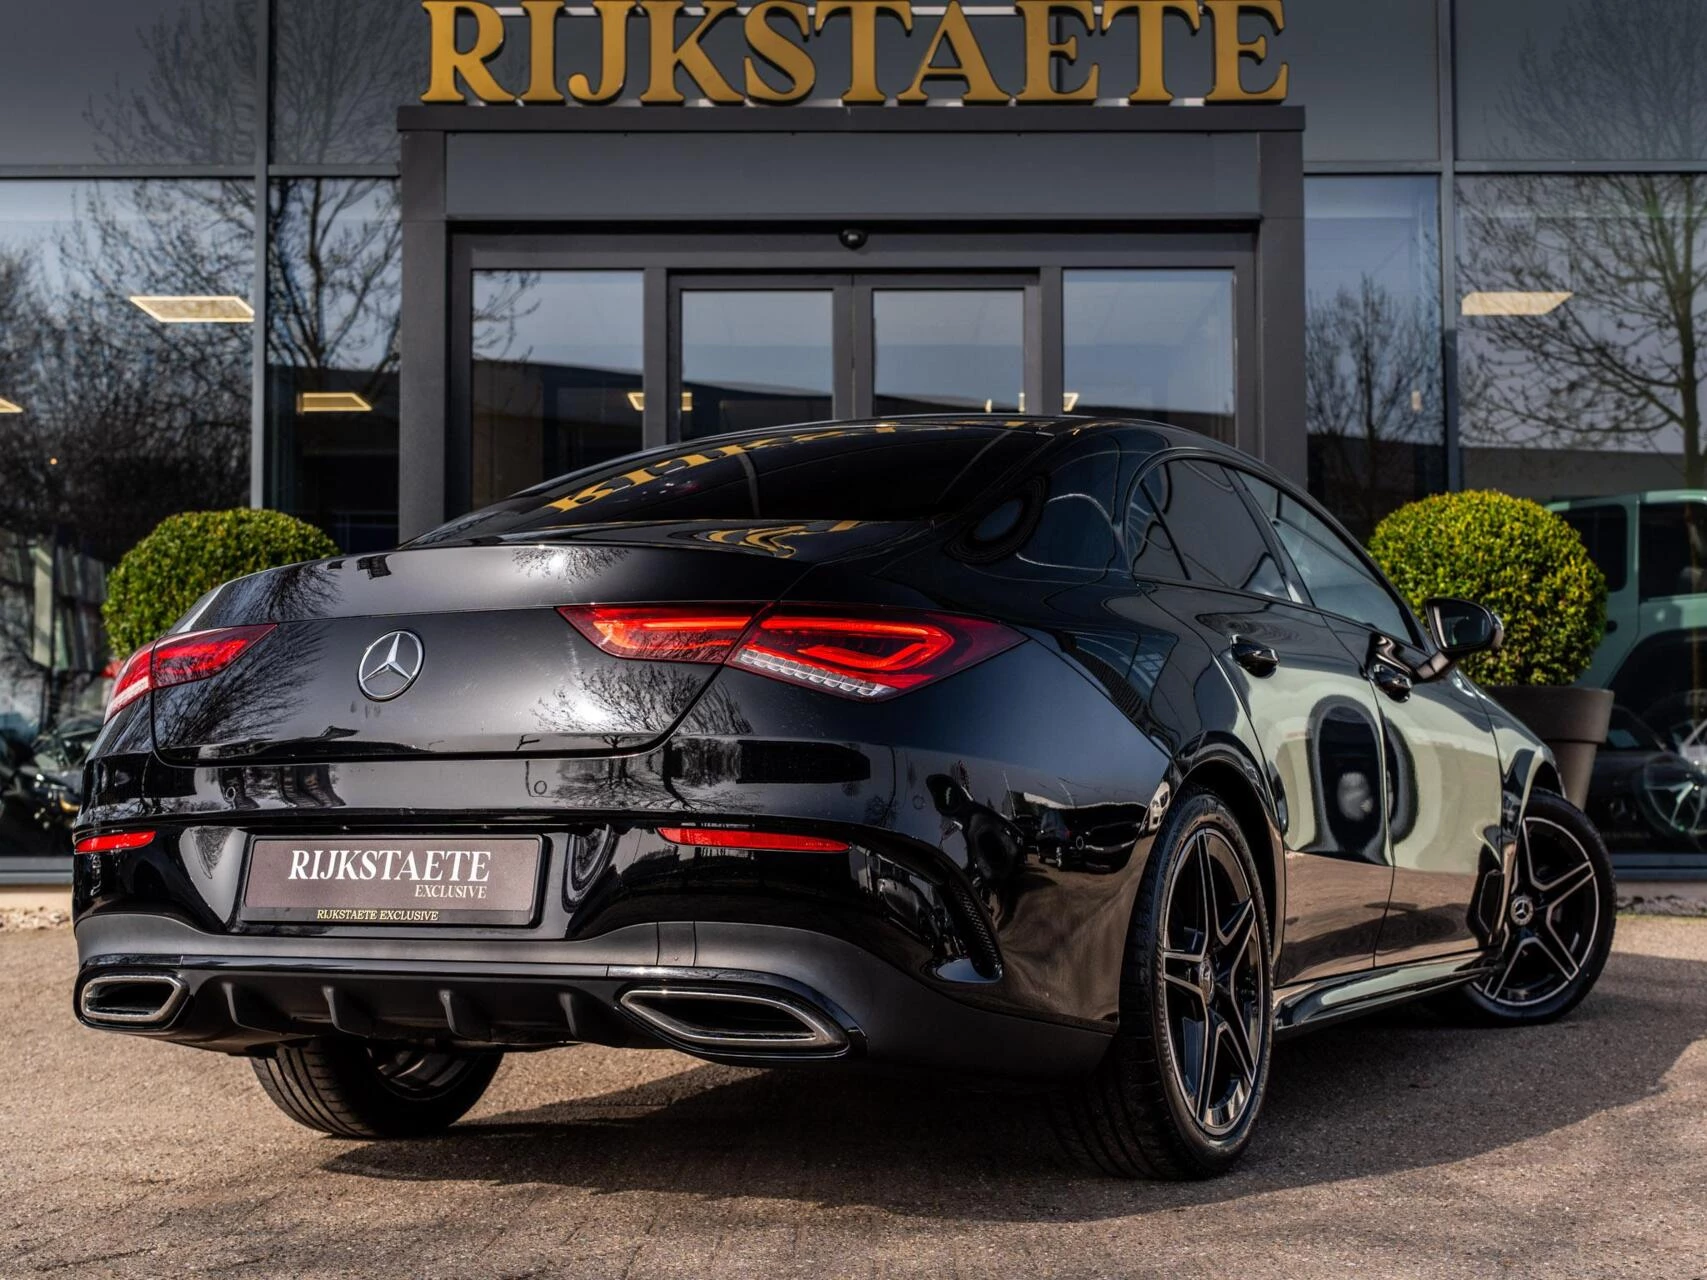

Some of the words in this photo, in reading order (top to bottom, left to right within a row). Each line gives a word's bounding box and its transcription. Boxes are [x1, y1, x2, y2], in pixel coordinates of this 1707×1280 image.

[421, 0, 1288, 102] RIJKSTAETE
[288, 850, 491, 881] RIJKSTAETE
[414, 884, 487, 899] EXCLUSIVE
[317, 909, 377, 920] RIJKSTAETE
[379, 910, 439, 921] EXCLUSIVE
